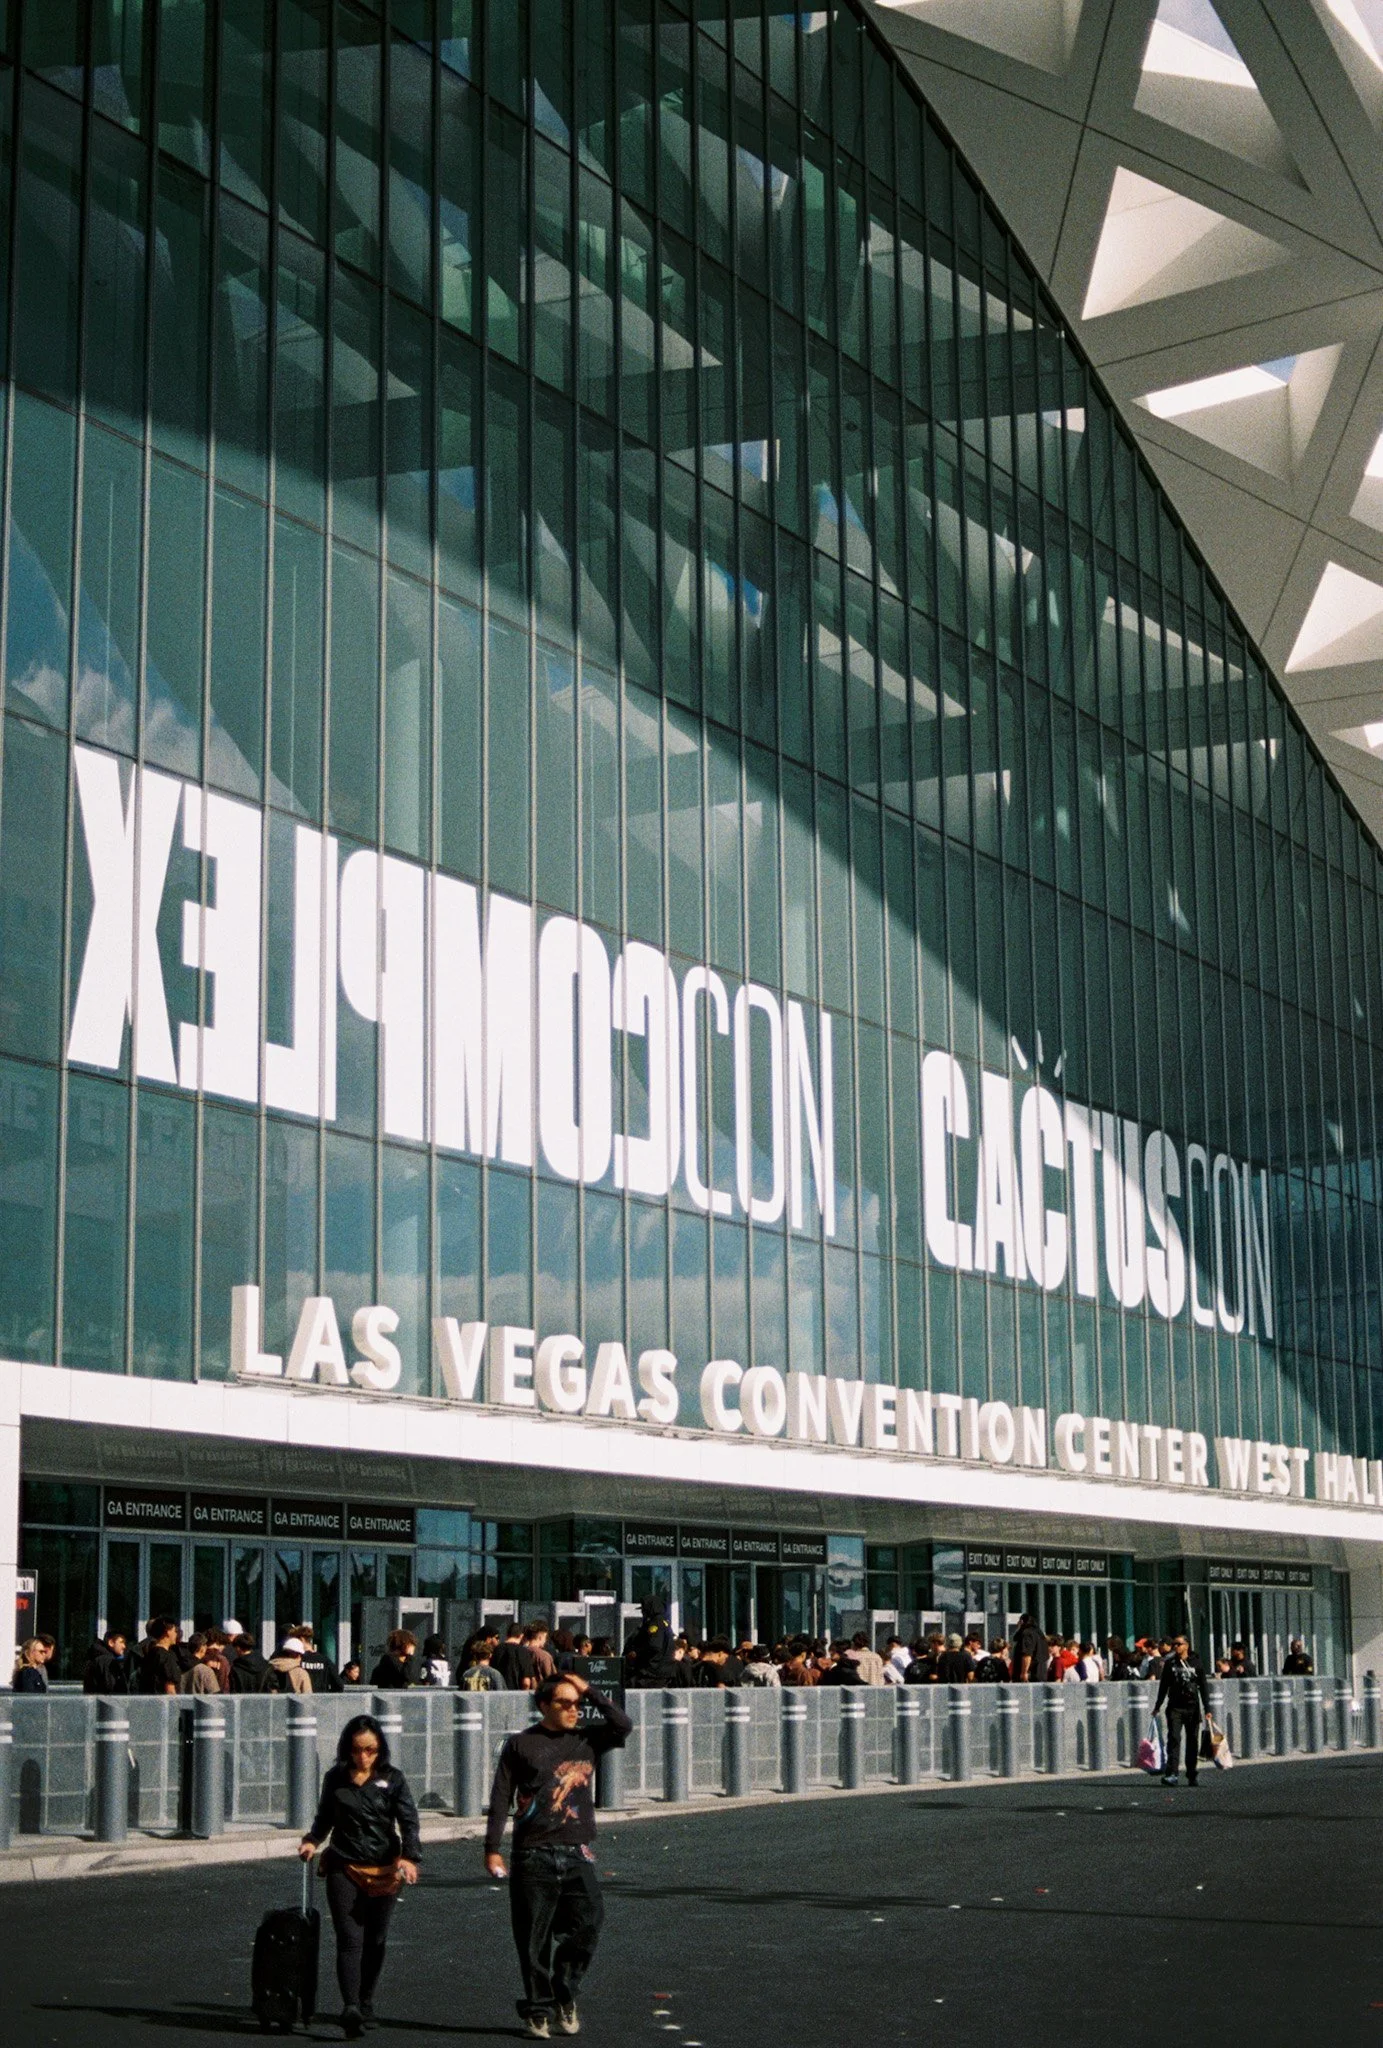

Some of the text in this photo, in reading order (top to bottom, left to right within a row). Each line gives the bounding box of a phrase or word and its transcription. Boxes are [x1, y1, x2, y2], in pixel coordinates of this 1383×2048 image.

[230, 1285, 401, 1390] LAS
[433, 1317, 679, 1424] VEGAS
[700, 1360, 1047, 1467] CONVENTION
[1054, 1413, 1209, 1486] CENTER
[1214, 1437, 1310, 1498] WEST
[107, 1501, 182, 1518] GA ENTRANCE
[194, 1507, 263, 1524] GA ENTRANCE
[274, 1512, 340, 1528] GA ENTRANCE
[350, 1516, 411, 1532] GA ENTRANCE
[626, 1533, 675, 1548] GA ENTRANCE
[681, 1536, 727, 1550] GA ENTRANCE
[733, 1540, 777, 1553] GA ENTRANCE
[783, 1543, 823, 1555] GA ENTRANCE
[969, 1552, 1001, 1566] EXIT ONLY
[1006, 1555, 1037, 1568] EXIT ONLY
[1042, 1557, 1071, 1570] EXIT ONLY
[1077, 1559, 1105, 1572] EXIT ONLY
